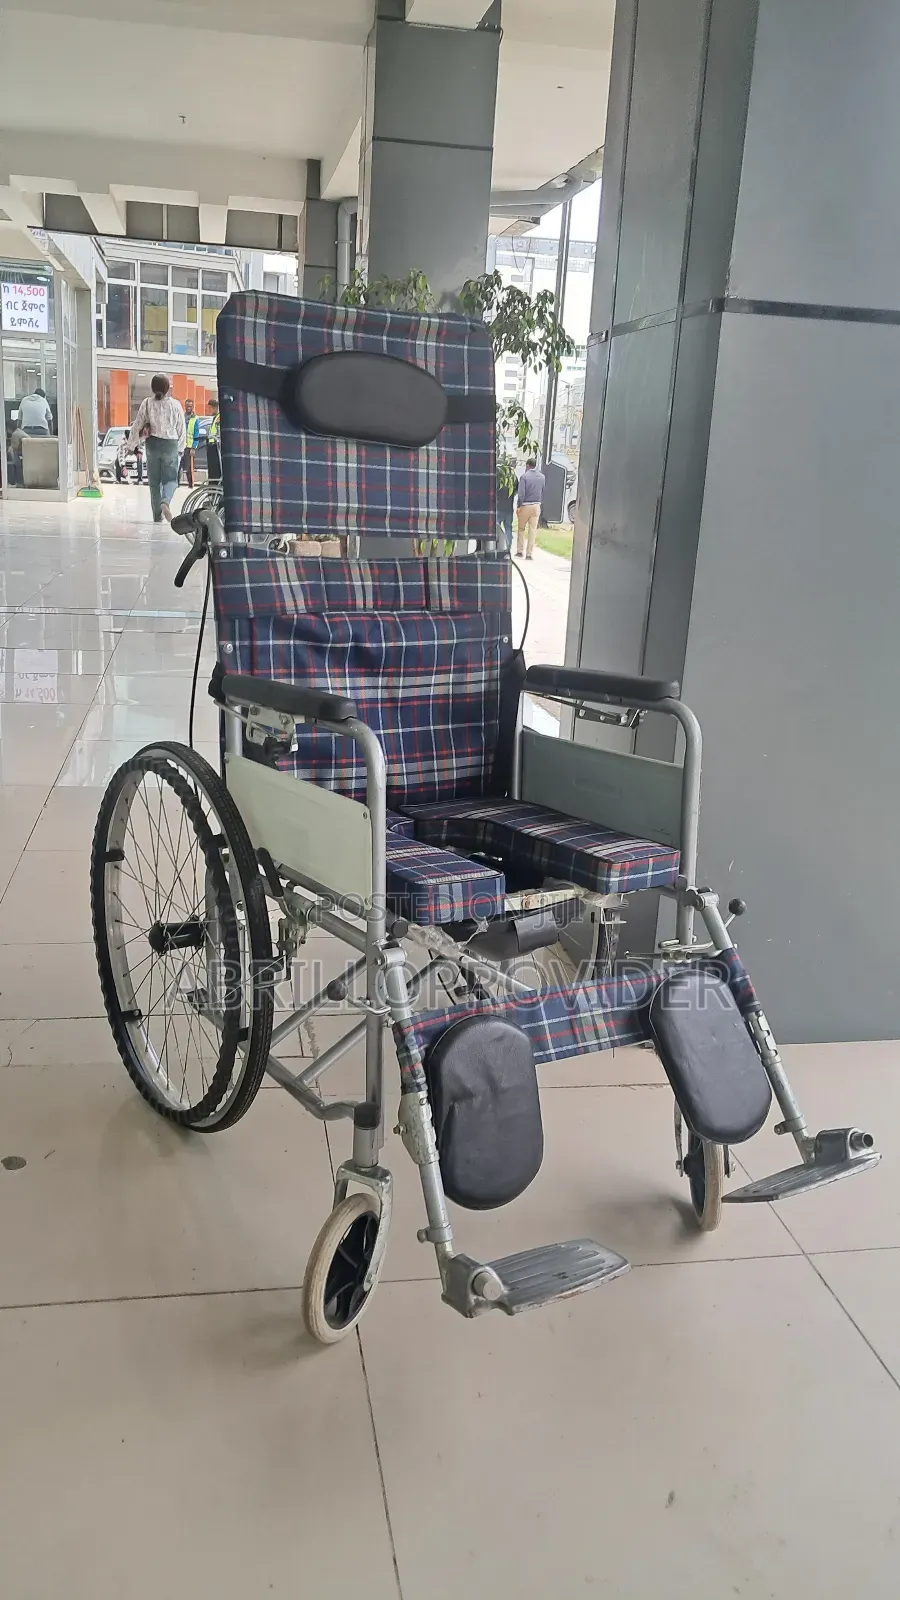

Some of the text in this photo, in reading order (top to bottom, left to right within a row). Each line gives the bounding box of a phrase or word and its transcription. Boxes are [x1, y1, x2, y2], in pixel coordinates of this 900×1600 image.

[3, 284, 45, 297] ከ 14,500
[5, 300, 46, 313] ብር ጀምሮ
